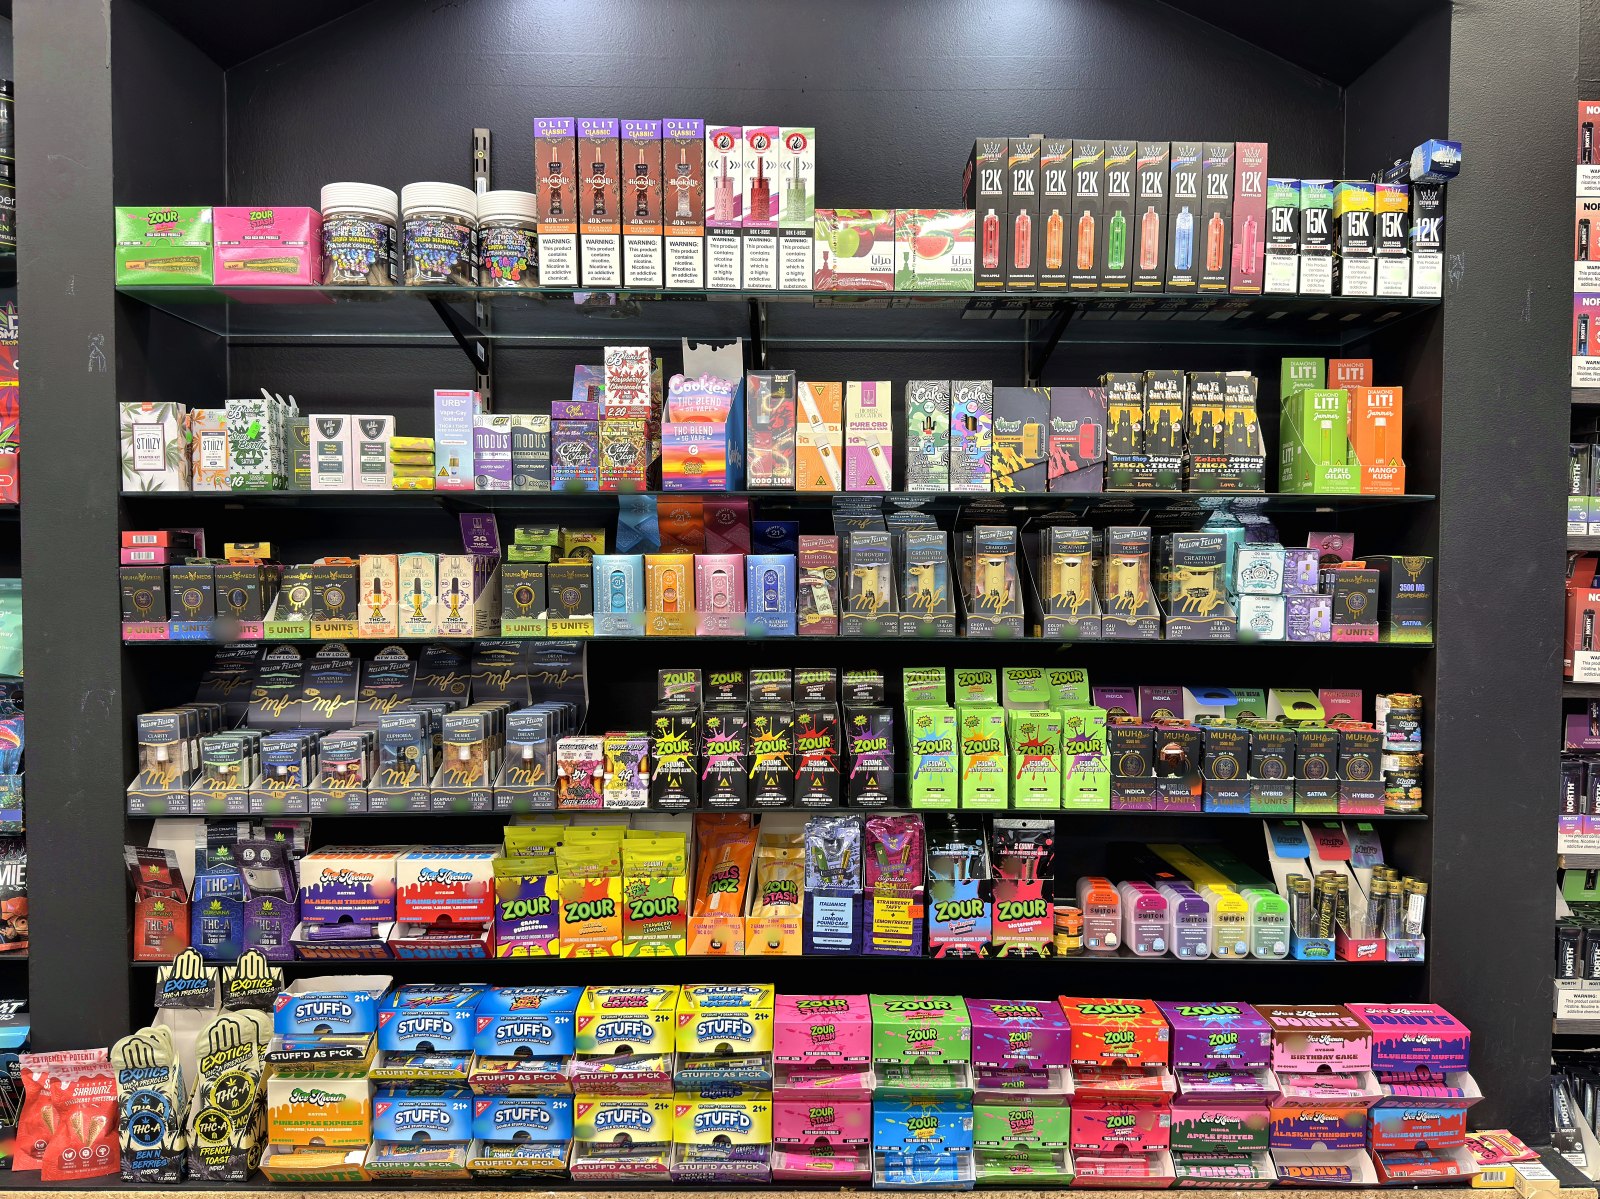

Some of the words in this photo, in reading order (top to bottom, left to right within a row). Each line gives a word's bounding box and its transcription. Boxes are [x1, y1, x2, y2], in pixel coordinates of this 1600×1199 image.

[538, 120, 570, 128] OLIT
[625, 122, 657, 130] OLIT
[667, 121, 699, 130] OLIT
[541, 128, 566, 136] CLASSIC
[981, 170, 1002, 192] 12K
[1109, 172, 1130, 193] 12K
[1176, 173, 1196, 194] 12K
[148, 211, 178, 225] ZOUR
[250, 210, 273, 221] ZOUR
[1272, 208, 1293, 232] 15K
[251, 218, 274, 228] STASH
[1347, 212, 1369, 236] 15K
[1290, 367, 1317, 378] LIT!
[670, 380, 731, 395] Cookies
[1154, 381, 1166, 390] Not
[914, 387, 942, 402] Cake
[958, 387, 986, 402] Cake
[1314, 398, 1339, 409] LIT!
[1368, 395, 1393, 406] LIT!
[674, 426, 688, 435] THC
[690, 426, 713, 435] BLEND
[477, 433, 508, 448] MODUS
[514, 434, 546, 448] MODUS
[559, 444, 583, 455] Cali
[1200, 538, 1222, 546] FELLOW
[1399, 583, 1414, 591] 3500
[1415, 583, 1425, 591] MG
[269, 626, 274, 634] 5
[324, 624, 353, 632] UNITS
[1051, 670, 1084, 685] ZOUR
[399, 718, 416, 726] FELLOW
[656, 741, 689, 755] ZOUR
[754, 740, 787, 754] ZOUR
[917, 739, 952, 755] ZOUR
[1566, 783, 1574, 812] NORTH
[205, 878, 241, 892] THC-A
[763, 880, 798, 894] ZOUR
[763, 893, 797, 906] STASH
[502, 896, 551, 919] ZOUR
[565, 899, 614, 922] ZOUR
[935, 899, 983, 920] ZOUR
[203, 919, 230, 930] THC-A
[164, 979, 208, 991] EXOTICS
[296, 1002, 352, 1017] STUFF'D
[886, 1001, 950, 1011] ZOUR
[1270, 1016, 1359, 1027] DONUTS
[1367, 1015, 1455, 1025] DONUTS
[496, 1023, 552, 1038] STUFF'D
[698, 1022, 753, 1036] STUFF'D
[810, 1025, 835, 1035] ZOUR
[812, 1034, 835, 1043] STASH
[1105, 1031, 1134, 1044] ZOUR
[32, 1056, 67, 1064] EXTREMELY
[69, 1053, 95, 1061] POTENT!
[120, 1067, 168, 1083] EXOTICS
[136, 1150, 153, 1159] BEN
[154, 1150, 161, 1158] N
[200, 1146, 231, 1156] FRENCH
[132, 1158, 168, 1169] BERRIES
[206, 1155, 229, 1164] TOAST
